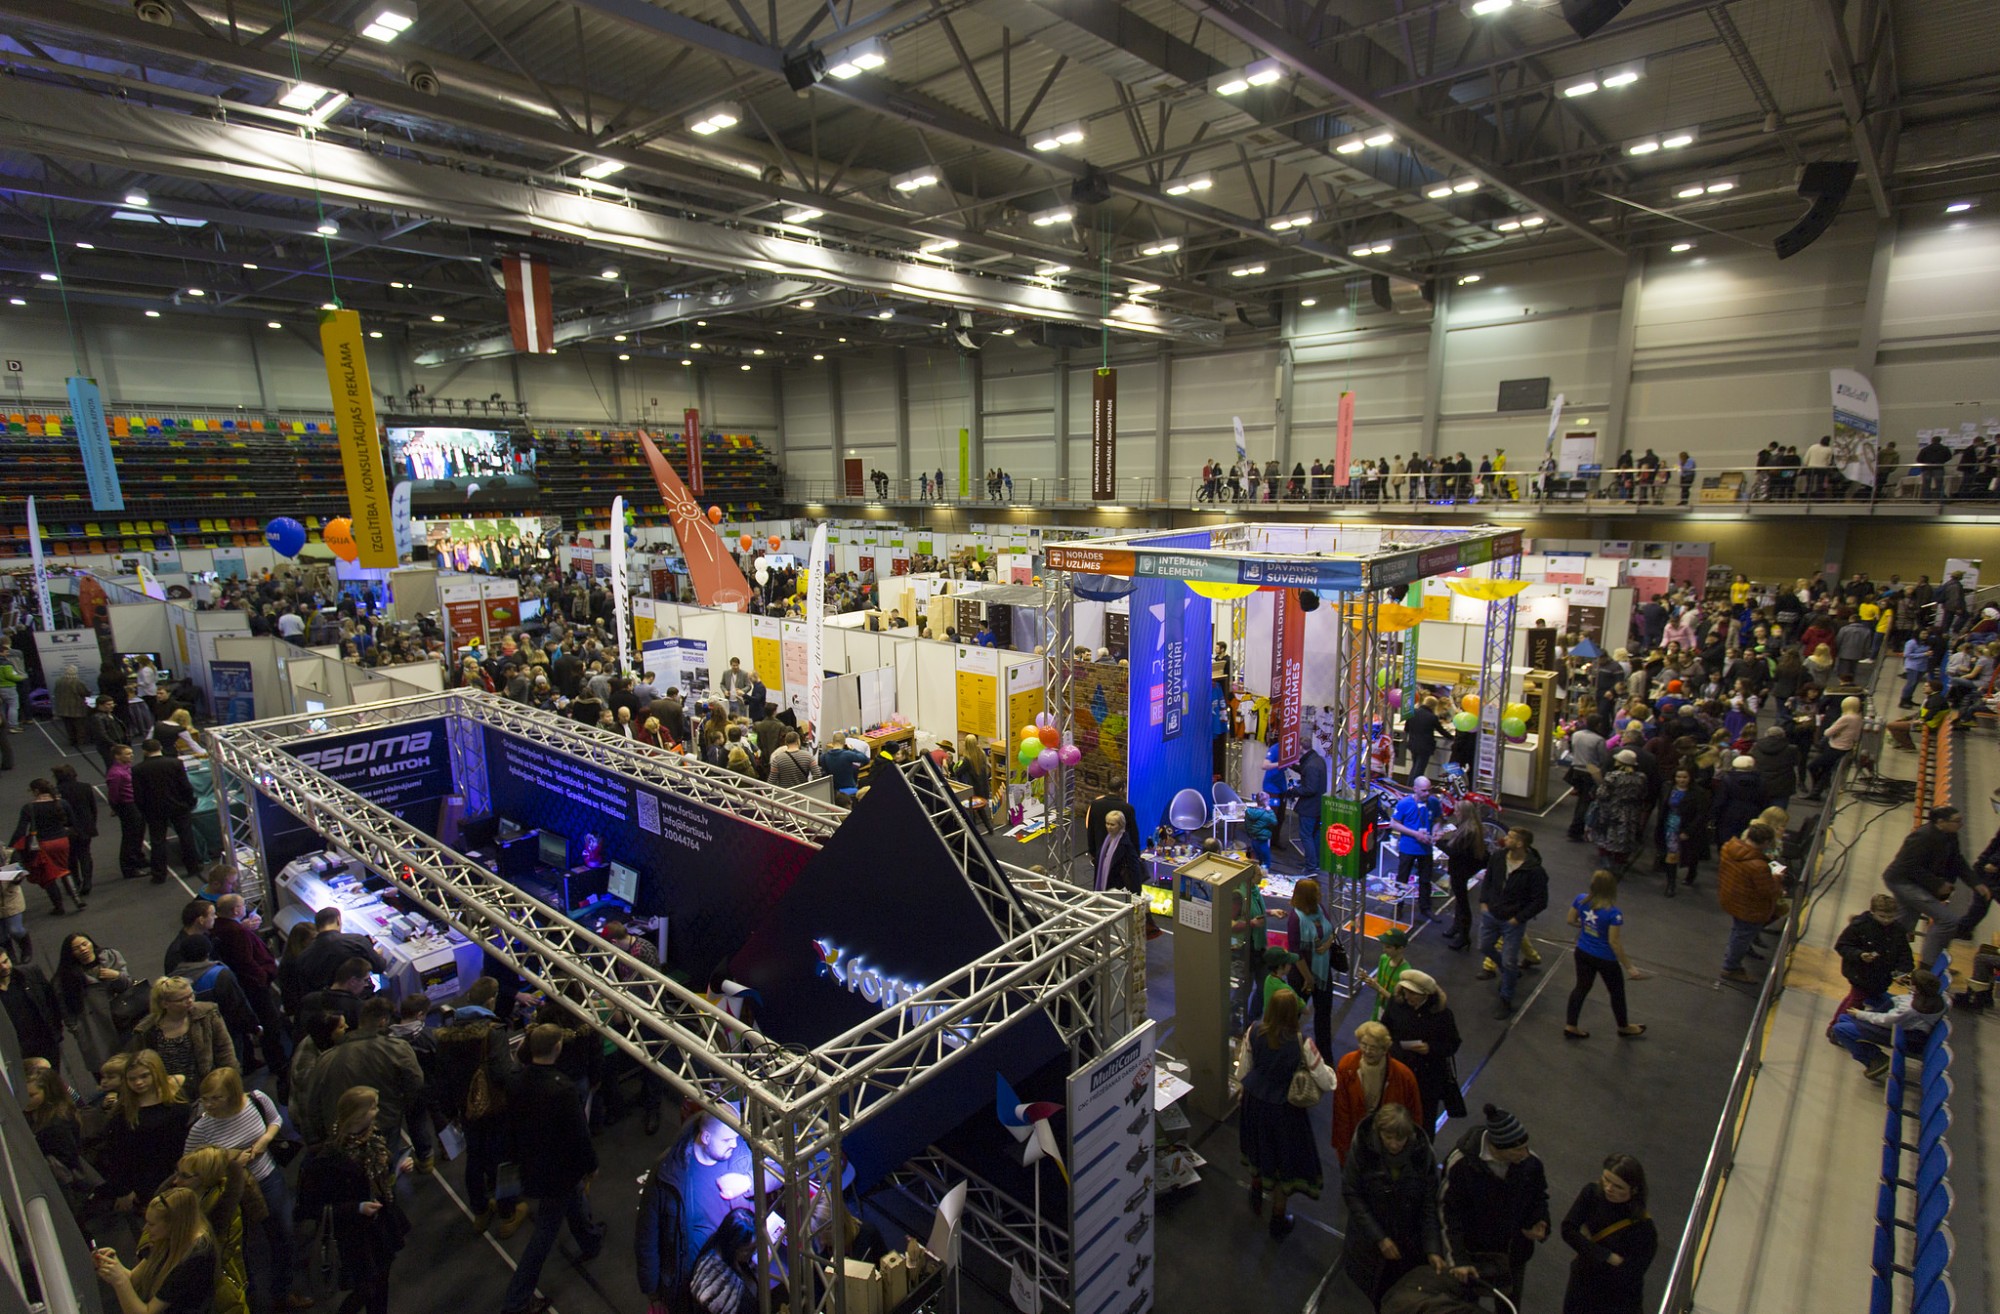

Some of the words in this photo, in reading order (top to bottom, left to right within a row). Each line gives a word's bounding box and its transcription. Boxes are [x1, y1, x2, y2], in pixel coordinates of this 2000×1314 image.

[8, 361, 20, 370] D
[340, 342, 359, 396] REKLĀMA
[350, 406, 375, 493] KONSULTĀCIJAS
[367, 503, 384, 552] IZGLĪTĪBA
[1066, 550, 1104, 560] NORĀDES
[1066, 560, 1101, 570] UZLĪMES
[1158, 556, 1209, 567] INTERJERA
[1158, 566, 1203, 577] ELEMENTI
[1266, 573, 1318, 584] SUVENĪRI
[1276, 588, 1286, 672] TEKSTILDRUK
[1166, 642, 1174, 706] DĀVANAS
[1174, 641, 1182, 702] SUVENĪRI
[1283, 658, 1293, 729] NORĀDES
[1290, 662, 1300, 726] UZLĪMES
[369, 756, 431, 777] MUTOH
[661, 800, 709, 825] www.fortius.lv
[662, 814, 713, 842] info@fortius.lv
[664, 829, 700, 851] 20044764
[1092, 1048, 1139, 1090] MultiCam
